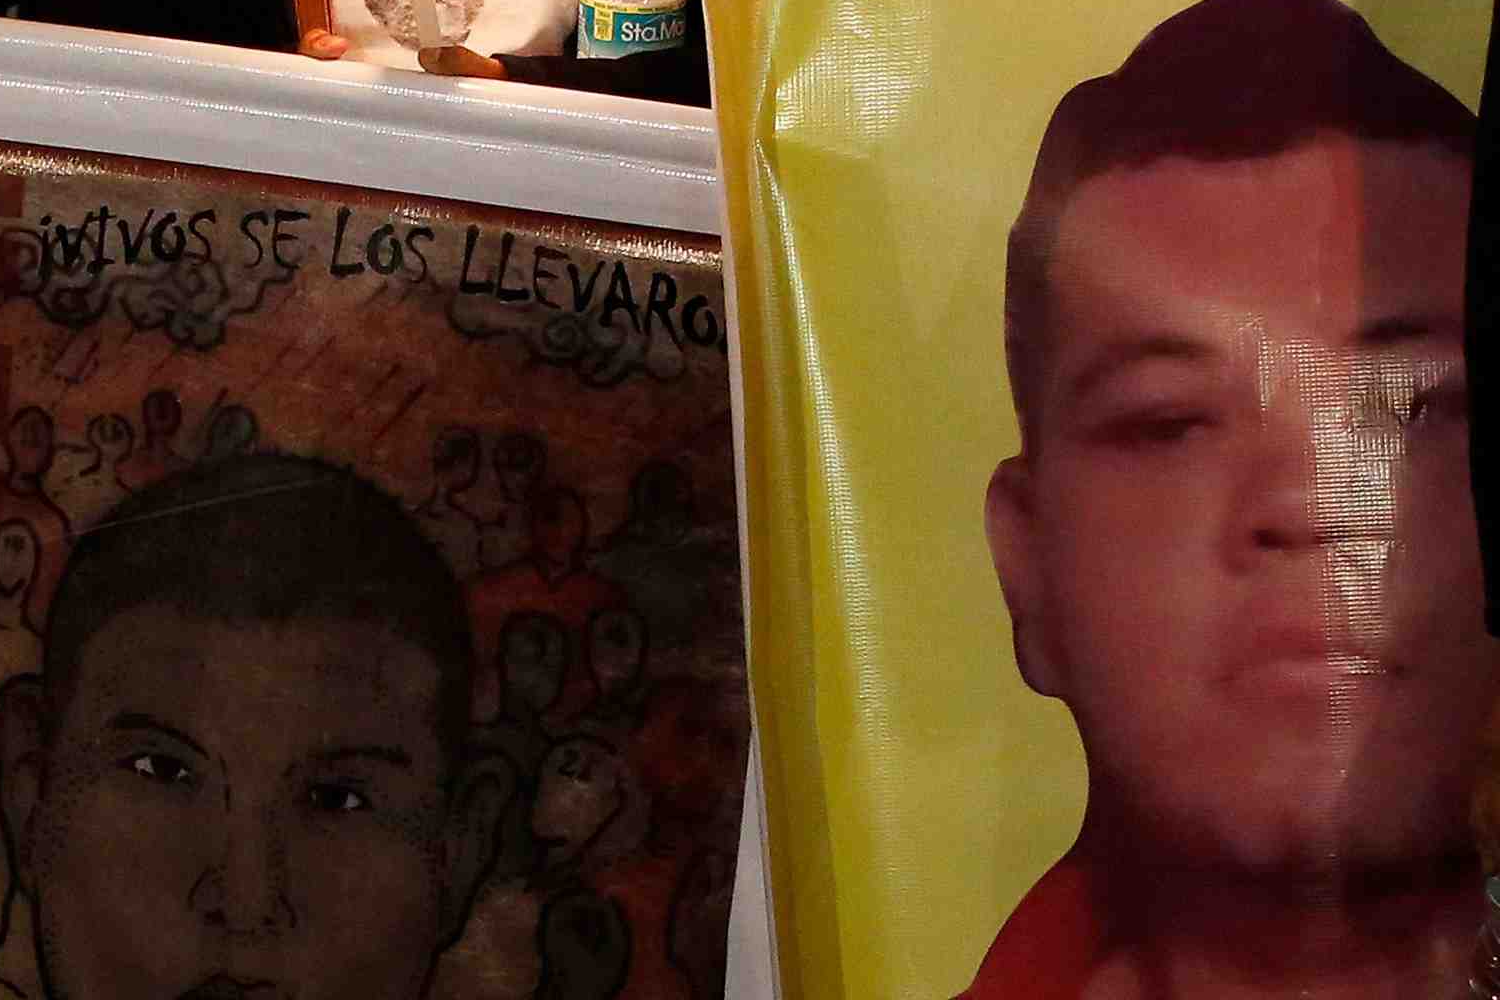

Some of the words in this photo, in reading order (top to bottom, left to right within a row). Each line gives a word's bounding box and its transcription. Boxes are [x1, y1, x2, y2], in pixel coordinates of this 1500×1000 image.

[240, 209, 310, 270] SE
[330, 205, 435, 284] LOS
[459, 224, 727, 353] LLEVARO
